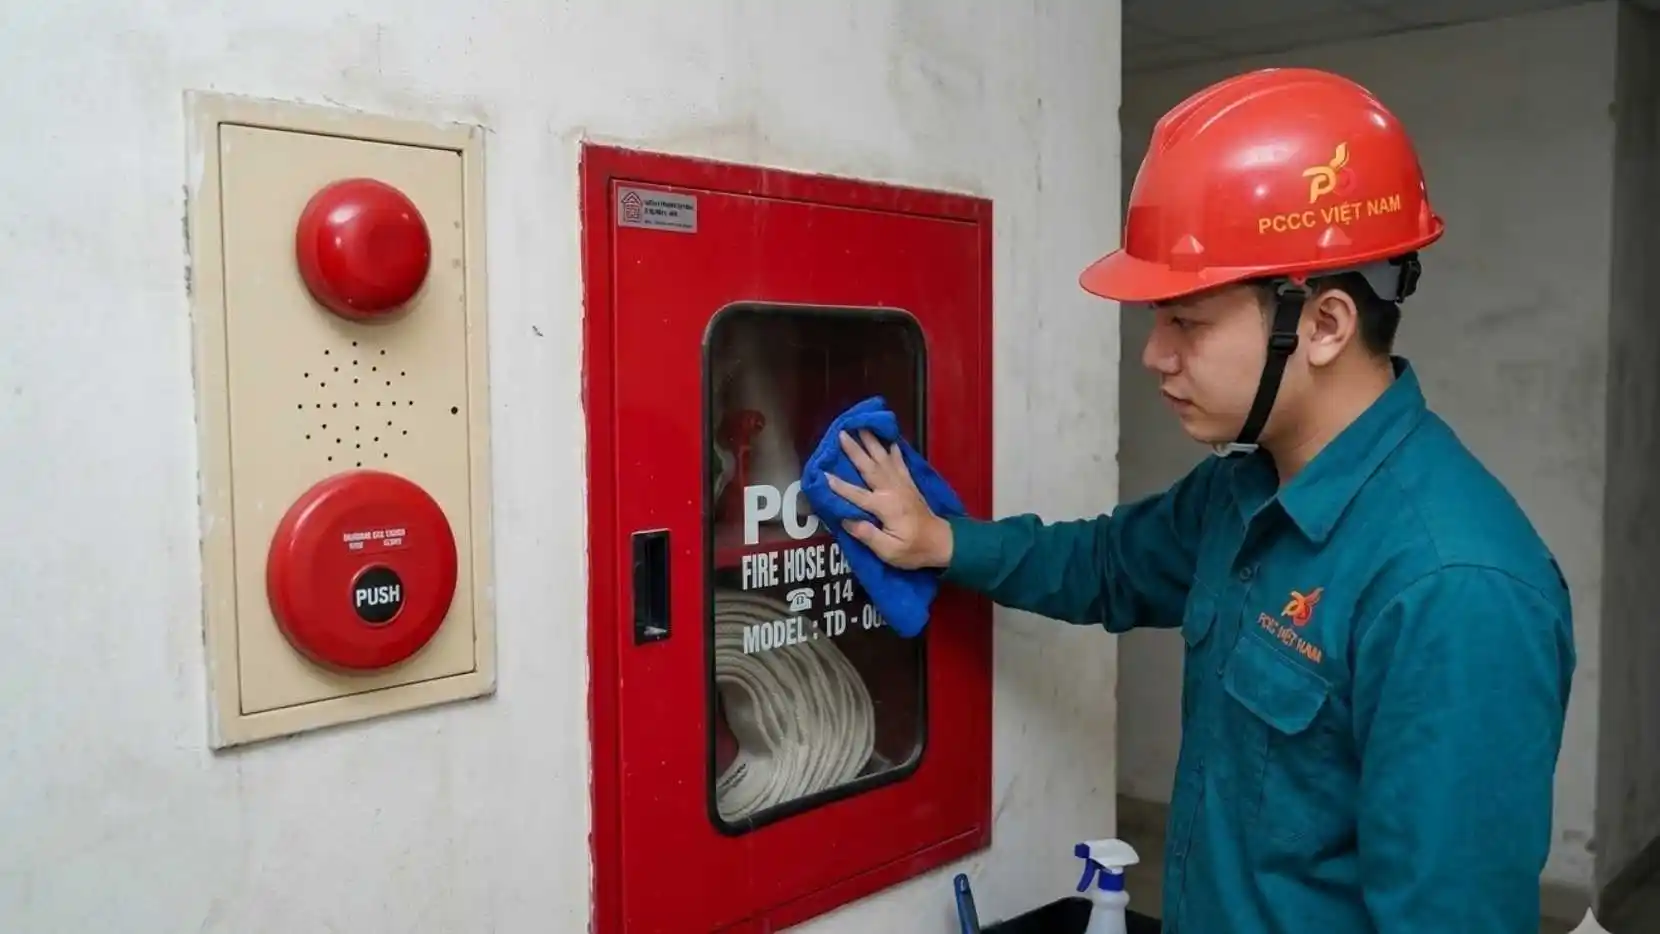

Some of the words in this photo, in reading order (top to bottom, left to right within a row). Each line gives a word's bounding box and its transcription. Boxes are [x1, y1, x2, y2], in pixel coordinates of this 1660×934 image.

[1258, 212, 1316, 233] PCCC
[1321, 202, 1362, 225] VIỆT
[1368, 194, 1401, 216] NAM
[744, 480, 826, 546] PC
[742, 552, 779, 590] FIRE
[784, 543, 825, 583] HOSE
[356, 584, 400, 608] PUSH
[823, 579, 853, 606] 114
[744, 616, 807, 655] MODEL
[823, 609, 846, 637] TD
[862, 603, 888, 629] 00
